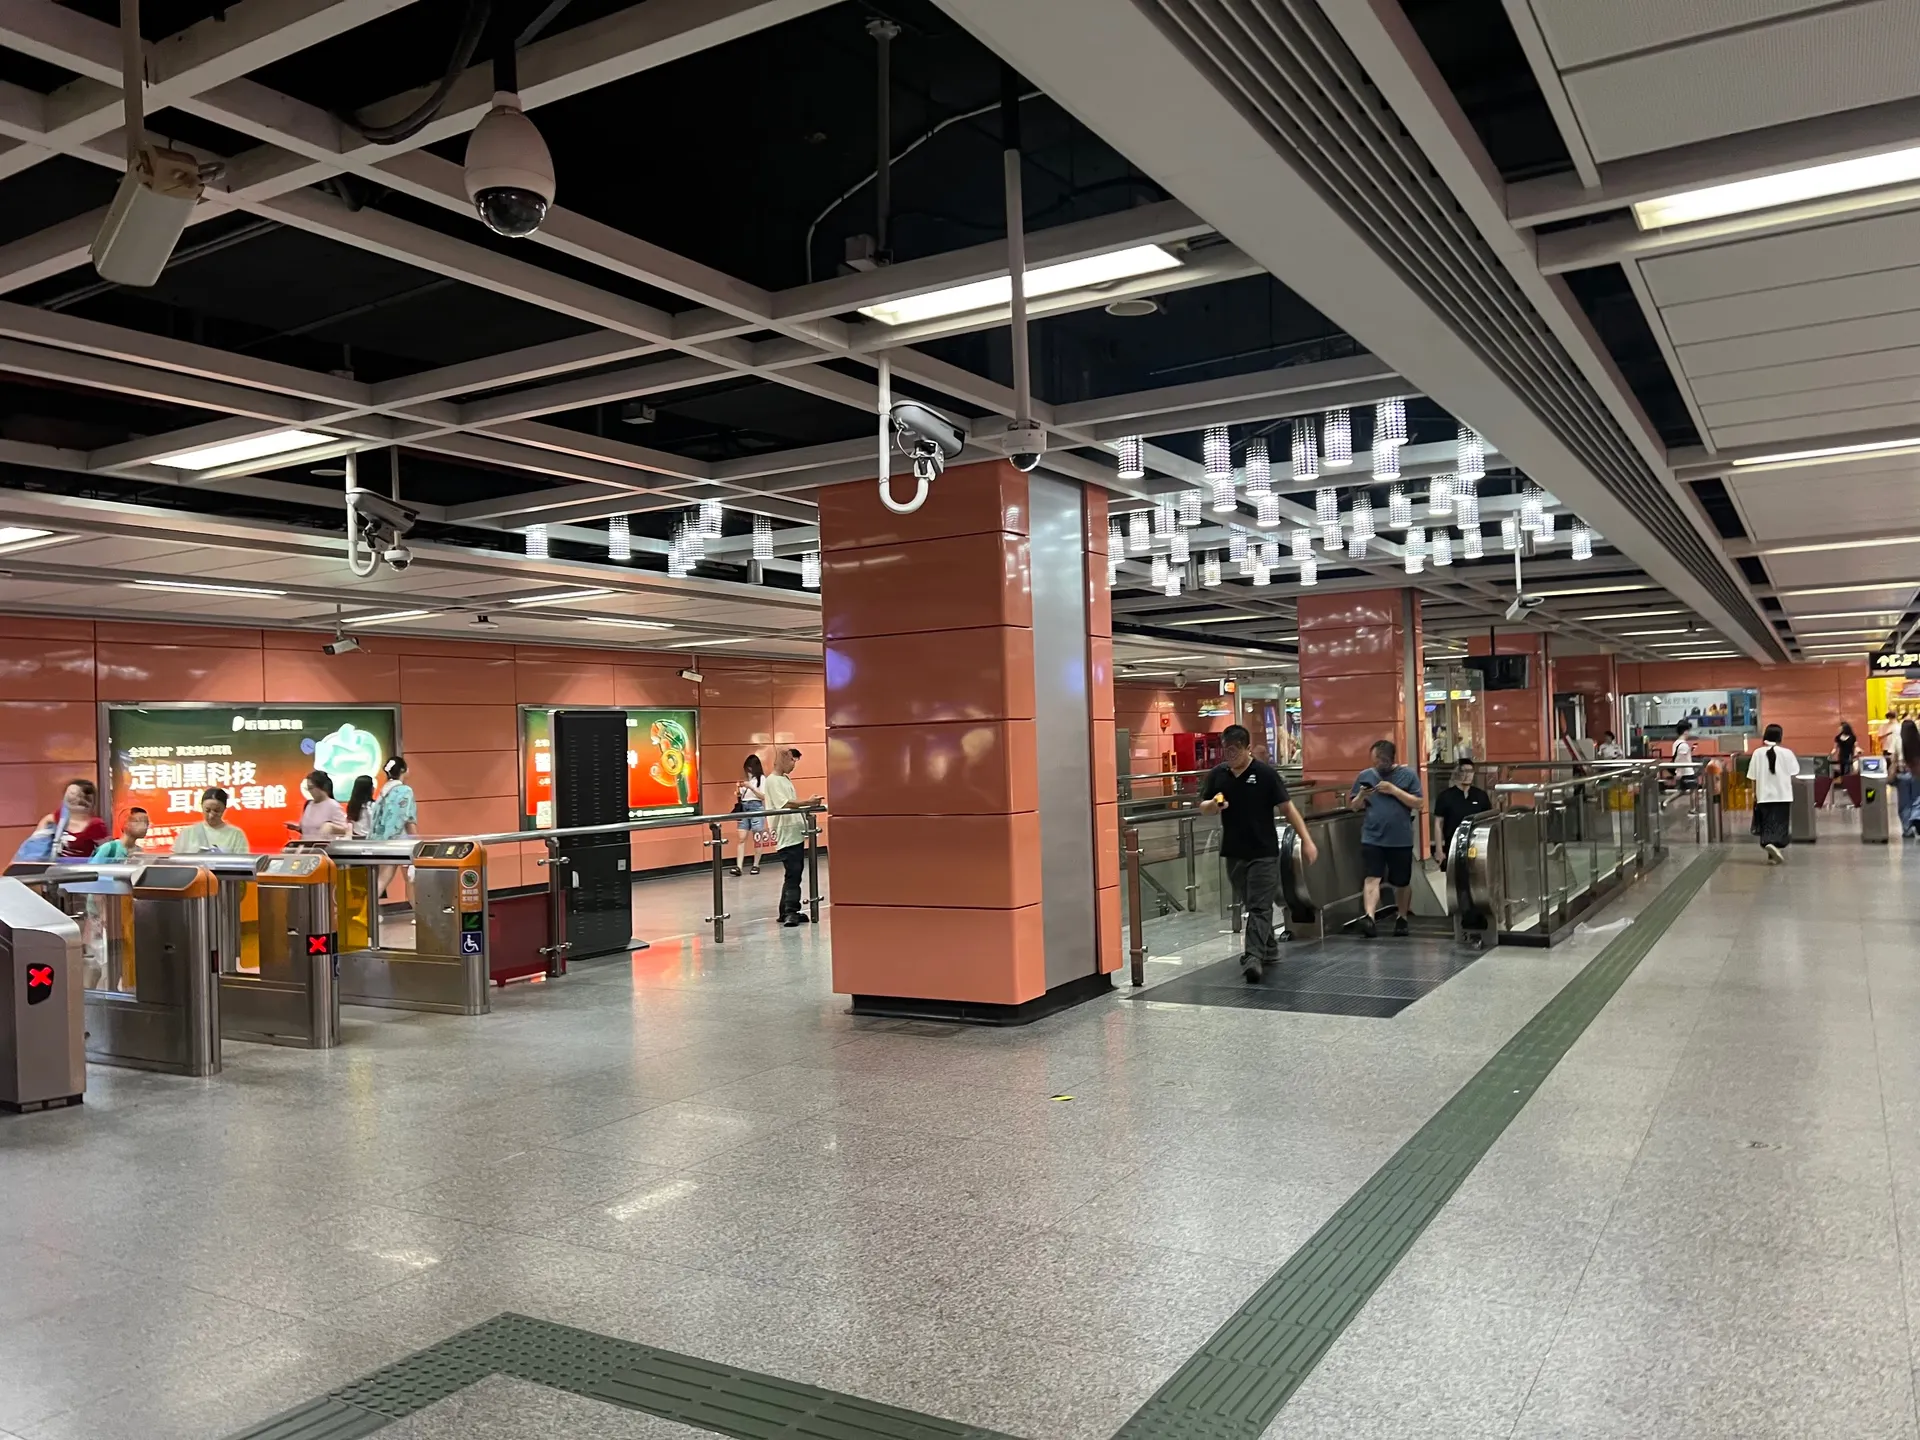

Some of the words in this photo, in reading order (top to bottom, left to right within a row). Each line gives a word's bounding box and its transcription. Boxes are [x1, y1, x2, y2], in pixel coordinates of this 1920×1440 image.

[128, 761, 257, 790] 定制黑科技
